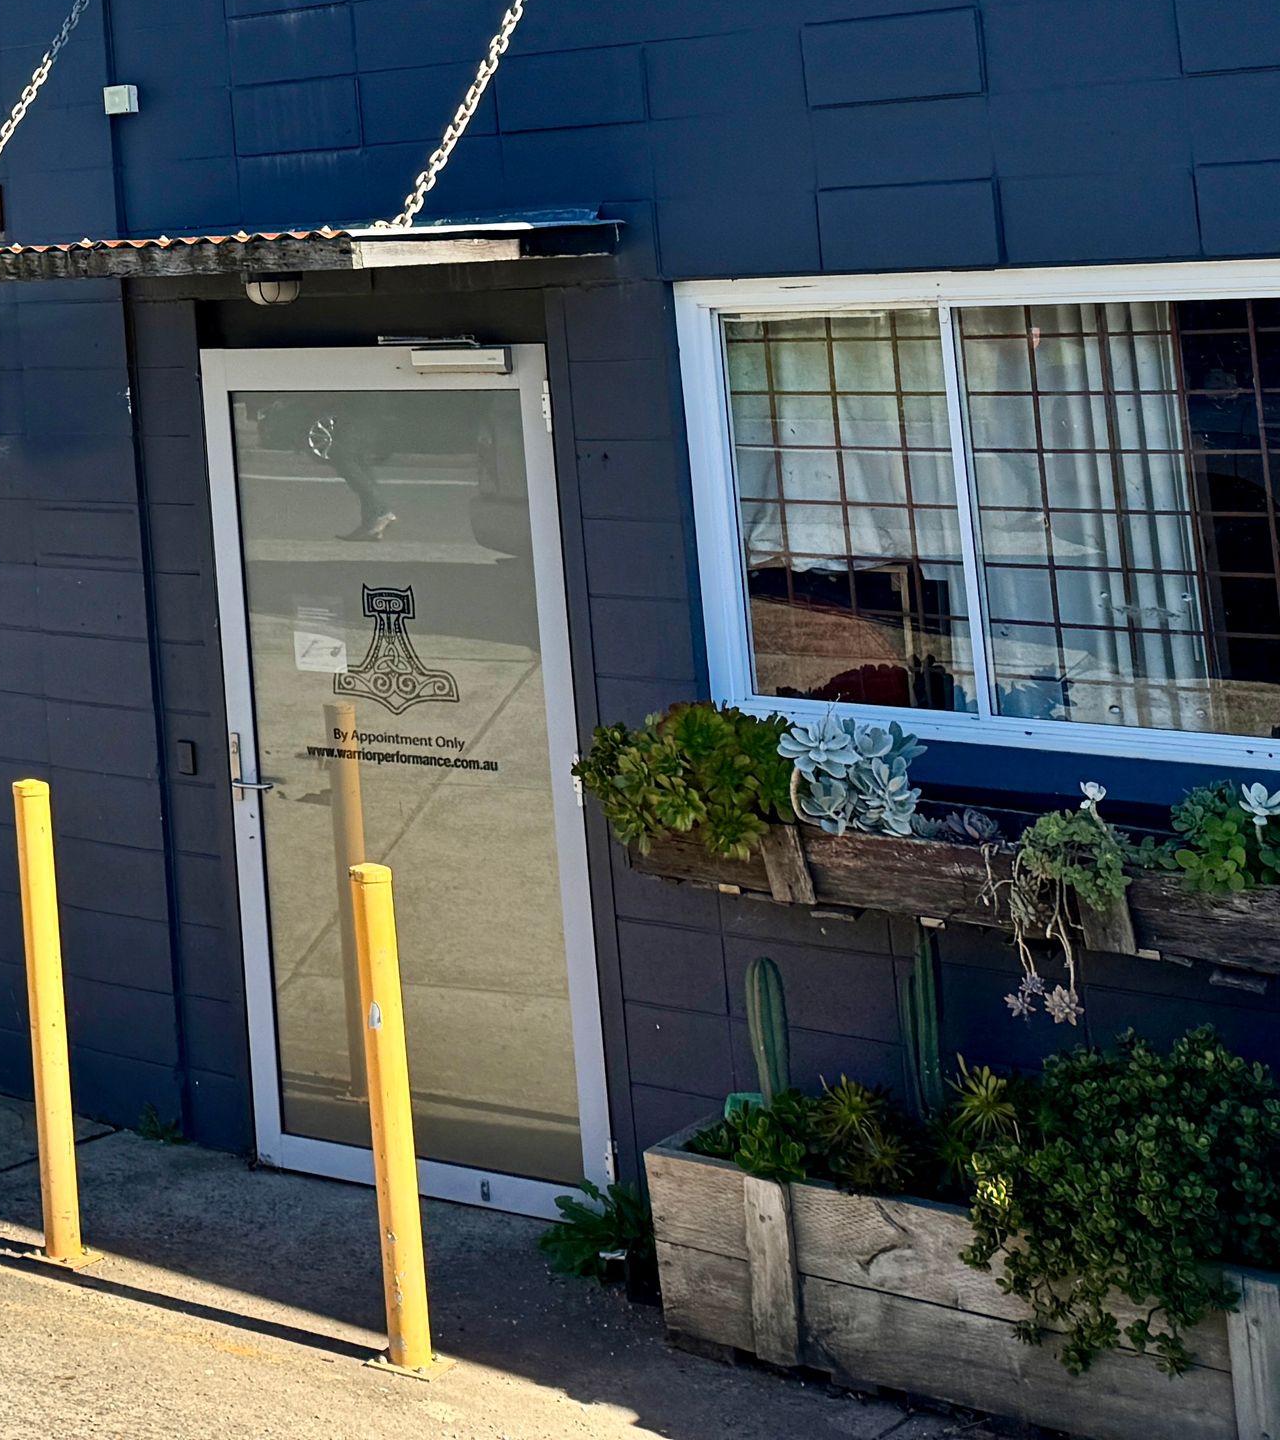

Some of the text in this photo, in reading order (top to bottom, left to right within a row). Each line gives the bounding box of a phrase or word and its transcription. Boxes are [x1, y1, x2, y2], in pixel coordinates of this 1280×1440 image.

[333, 727, 466, 752] By Appointment Only
[306, 745, 499, 772] www.warriorperformance.com.au
